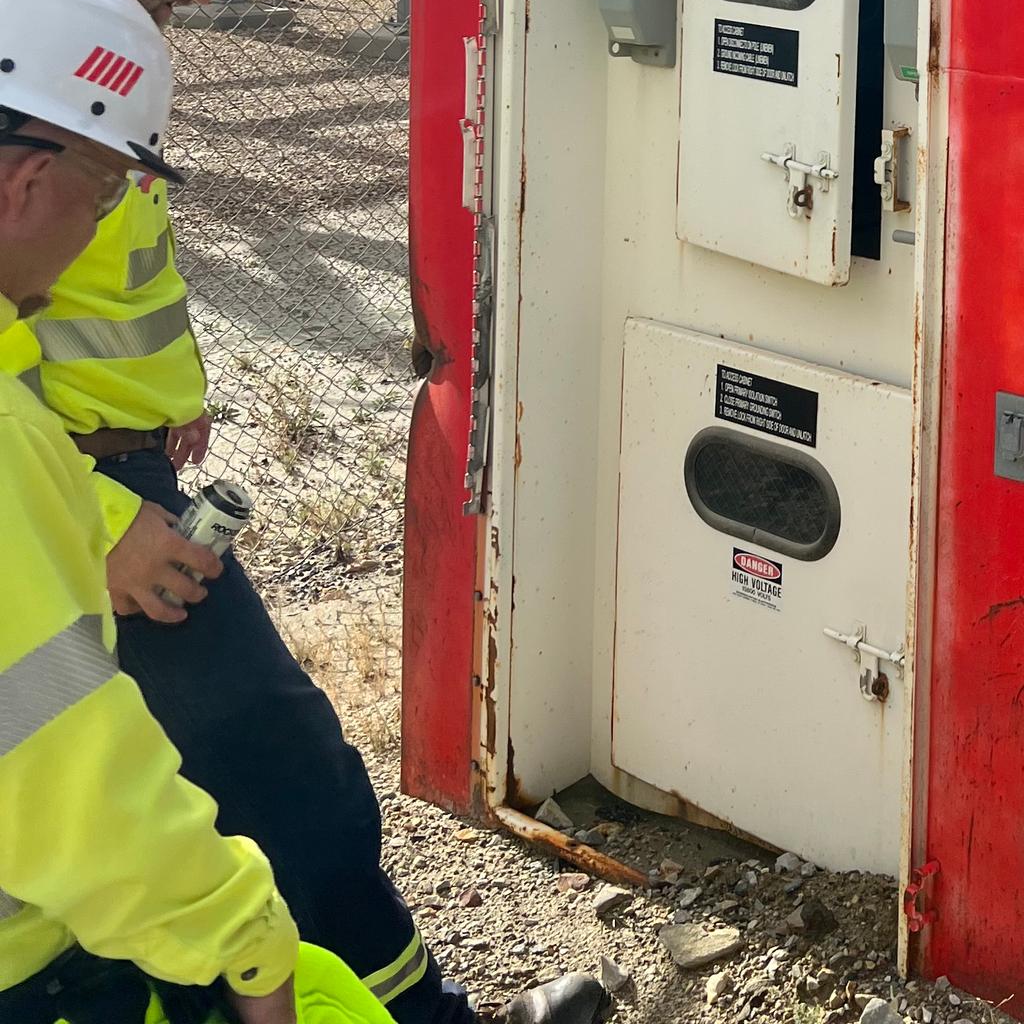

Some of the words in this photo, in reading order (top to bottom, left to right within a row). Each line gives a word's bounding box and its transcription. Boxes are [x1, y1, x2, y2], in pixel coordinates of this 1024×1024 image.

[740, 556, 774, 576] DANGER
[732, 571, 749, 585] HIGH
[751, 578, 782, 598] VOLTAGE
